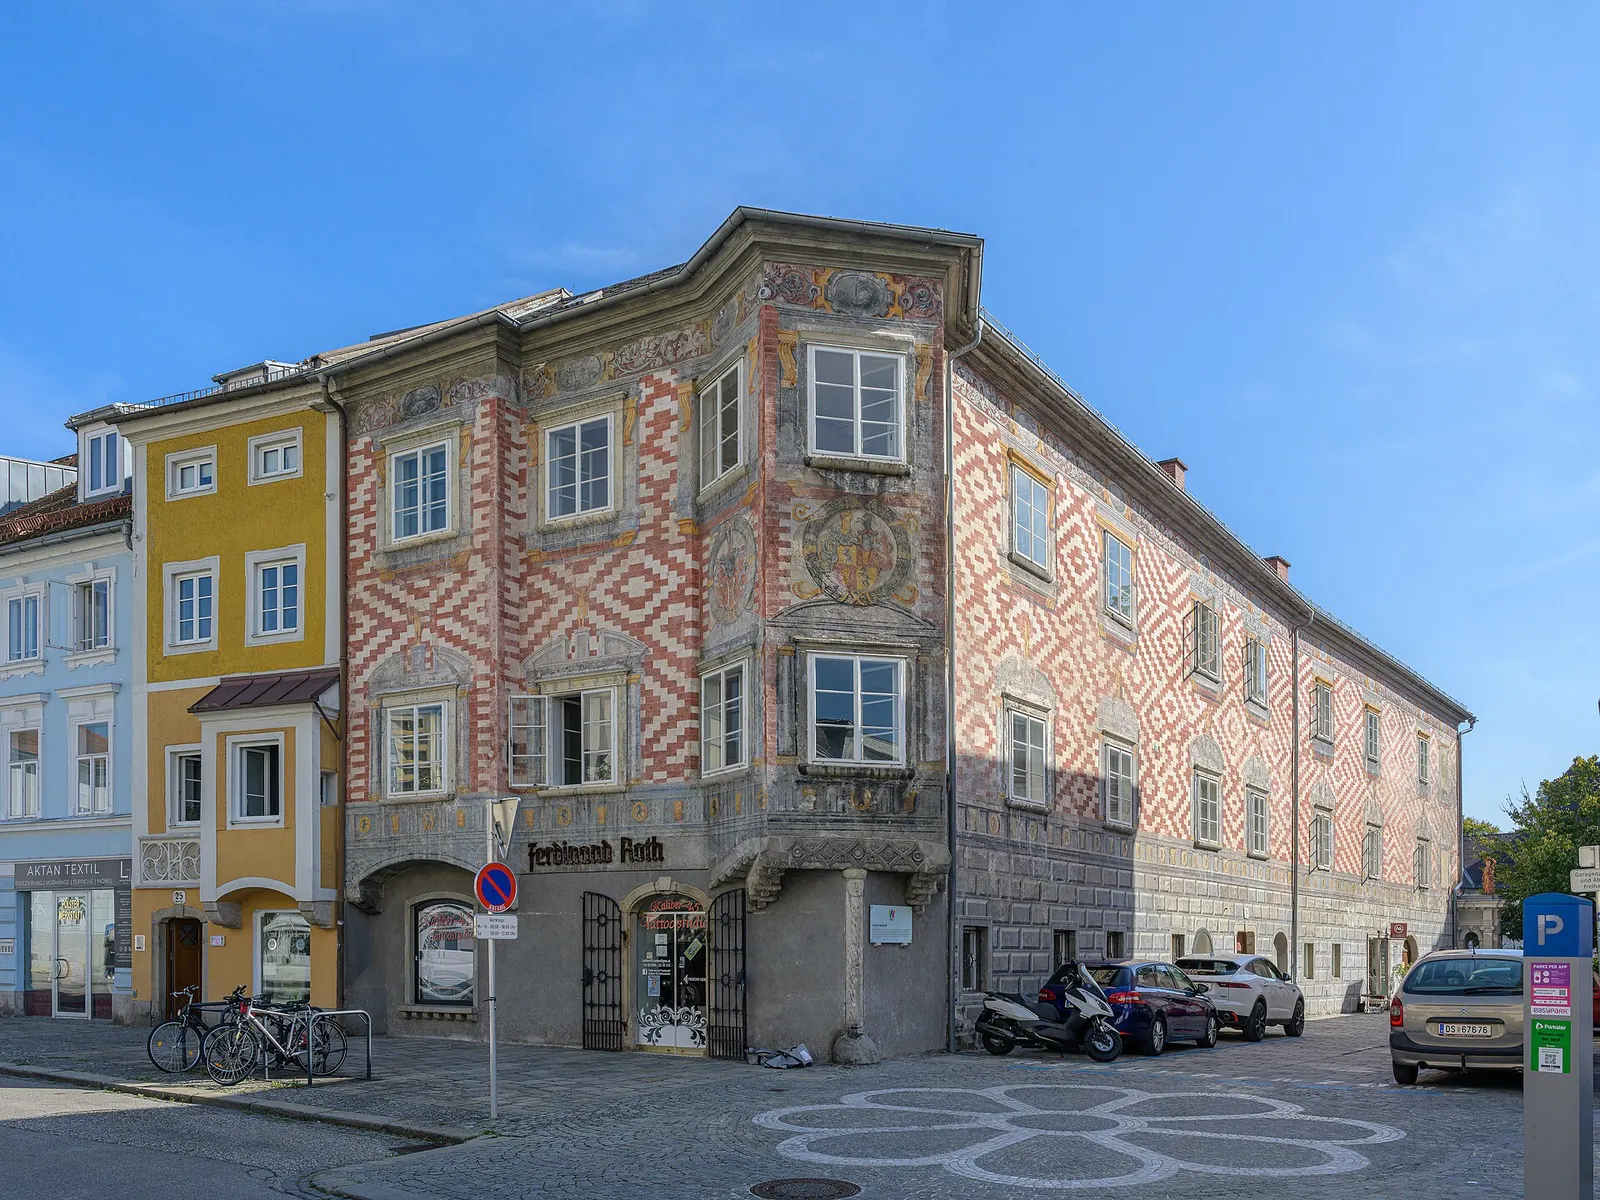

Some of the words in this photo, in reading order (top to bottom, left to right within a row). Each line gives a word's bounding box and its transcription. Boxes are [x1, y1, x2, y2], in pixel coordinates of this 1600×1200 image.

[527, 839, 613, 872] Ferdinand
[620, 835, 665, 863] Roth
[26, 864, 61, 876] AKTAN
[64, 863, 100, 875] TEXTIL
[175, 891, 184, 900] 25
[488, 903, 506, 912] ANFANG
[1537, 914, 1564, 946] P
